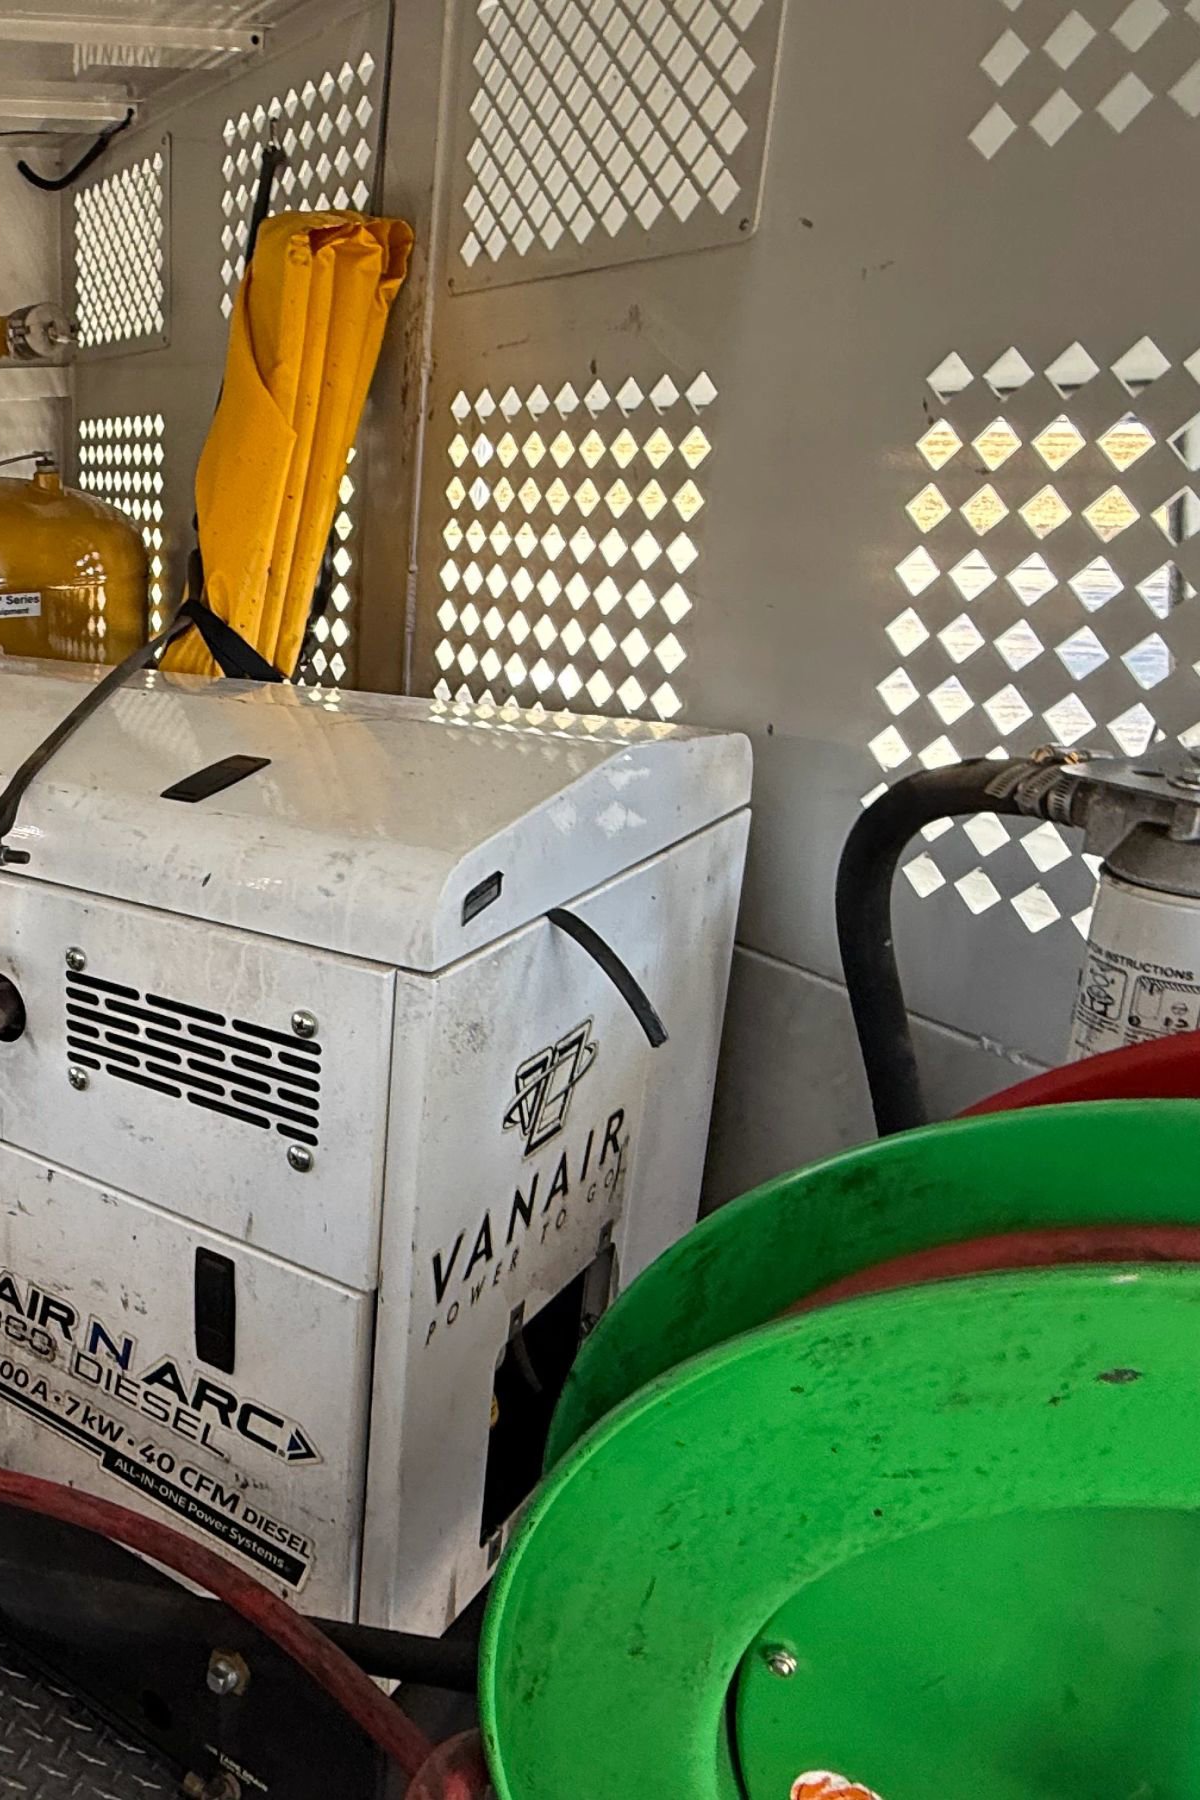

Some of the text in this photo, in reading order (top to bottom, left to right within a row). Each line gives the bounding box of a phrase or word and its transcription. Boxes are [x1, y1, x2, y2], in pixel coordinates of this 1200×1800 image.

[6, 595, 40, 605] Series
[425, 1168, 615, 1346] POWER TO GO
[432, 1108, 625, 1305] VANAIR
[74, 1351, 226, 1460] DIESEL
[88, 1320, 133, 1371] N
[141, 1361, 285, 1454] ARC
[31, 1380, 48, 1402] A
[139, 1444, 176, 1474] 40
[179, 1466, 241, 1515] CFM
[242, 1507, 311, 1560] DIESEL
[114, 1458, 285, 1570] ALL-IN-ONE Power Systems
